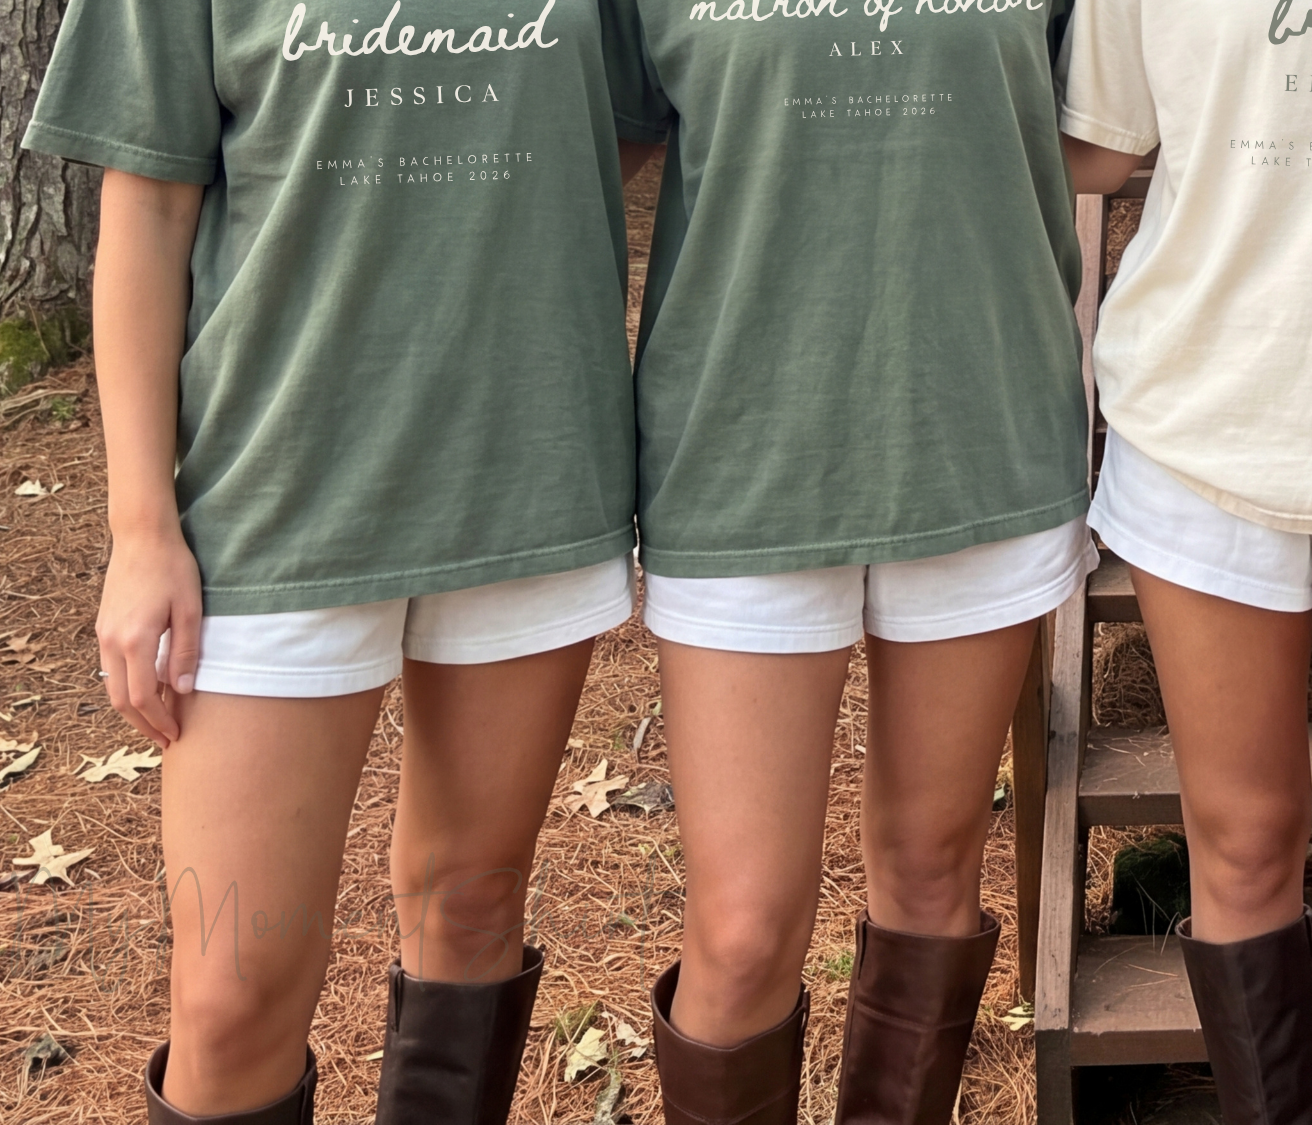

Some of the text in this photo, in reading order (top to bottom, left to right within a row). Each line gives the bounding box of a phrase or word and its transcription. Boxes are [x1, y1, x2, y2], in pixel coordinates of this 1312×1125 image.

[828, 39, 904, 57] ALEX
[344, 83, 500, 108] JESSICA
[784, 93, 953, 107] EMMA'S BACHELORETTE
[801, 106, 936, 119] LAKE TAHOE 2026
[1230, 139, 1295, 151] EMMA'S
[316, 152, 533, 170] EMMA'S BACHELORETTE
[1251, 156, 1291, 167] LAKE
[339, 169, 511, 186] LAKE TAHOE 2026
